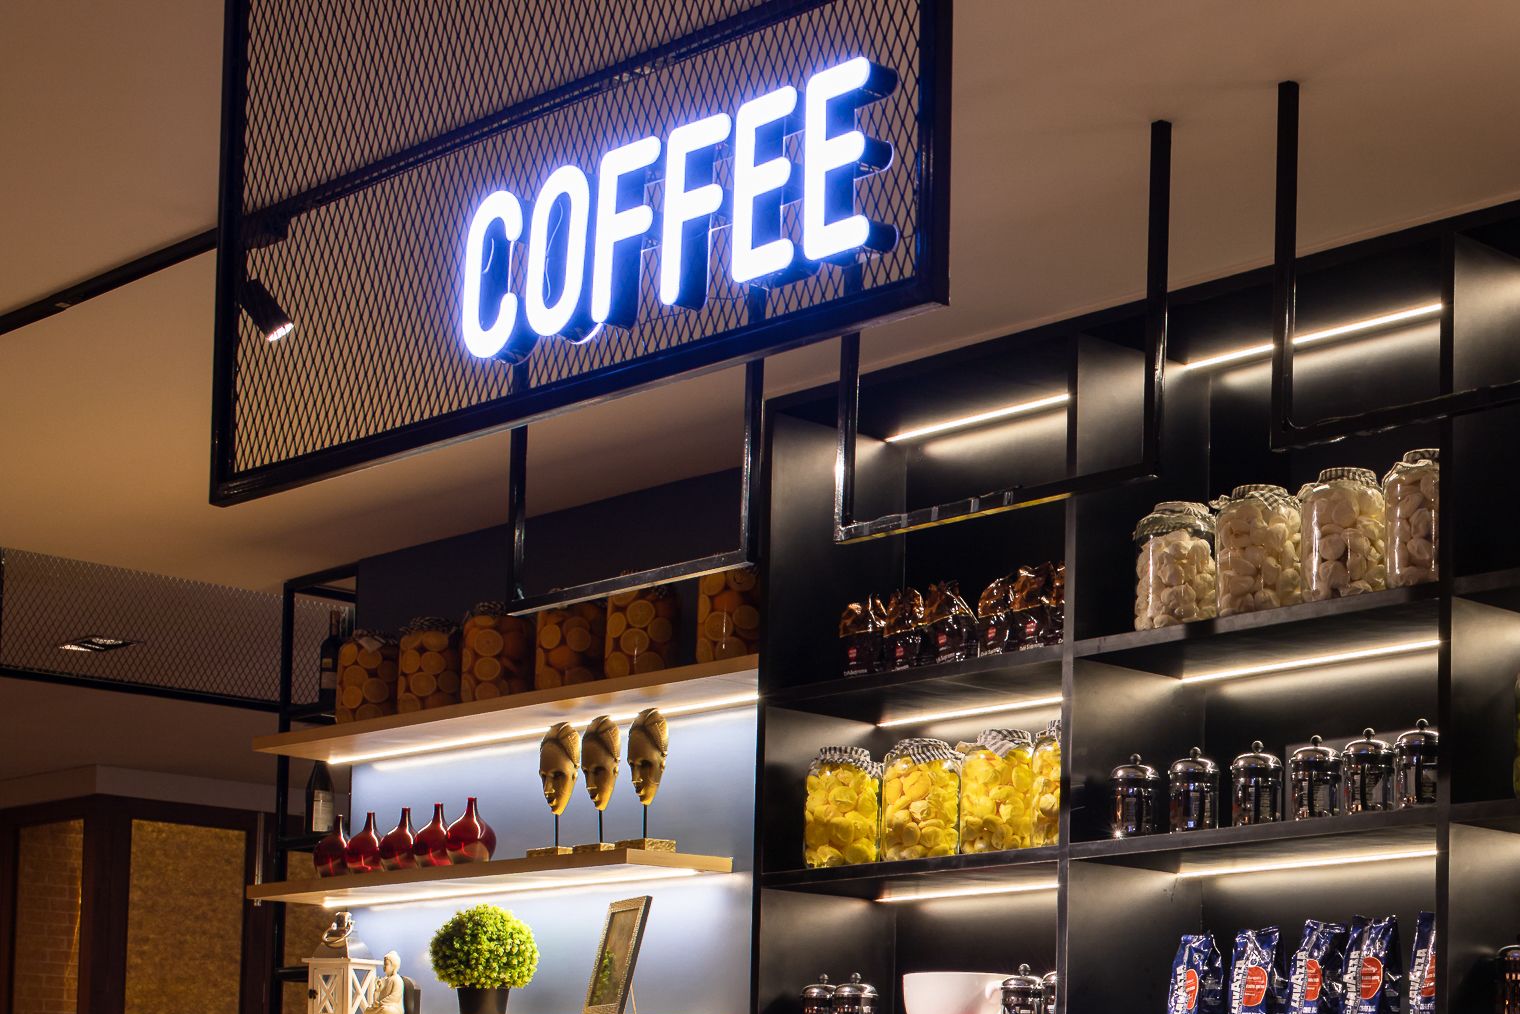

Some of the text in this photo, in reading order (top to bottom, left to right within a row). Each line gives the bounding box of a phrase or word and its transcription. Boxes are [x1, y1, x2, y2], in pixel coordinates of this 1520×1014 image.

[461, 56, 871, 361] COFFEE
[1291, 951, 1308, 1008] LAVAZZA
[1343, 950, 1361, 1007] LAVAZZA
